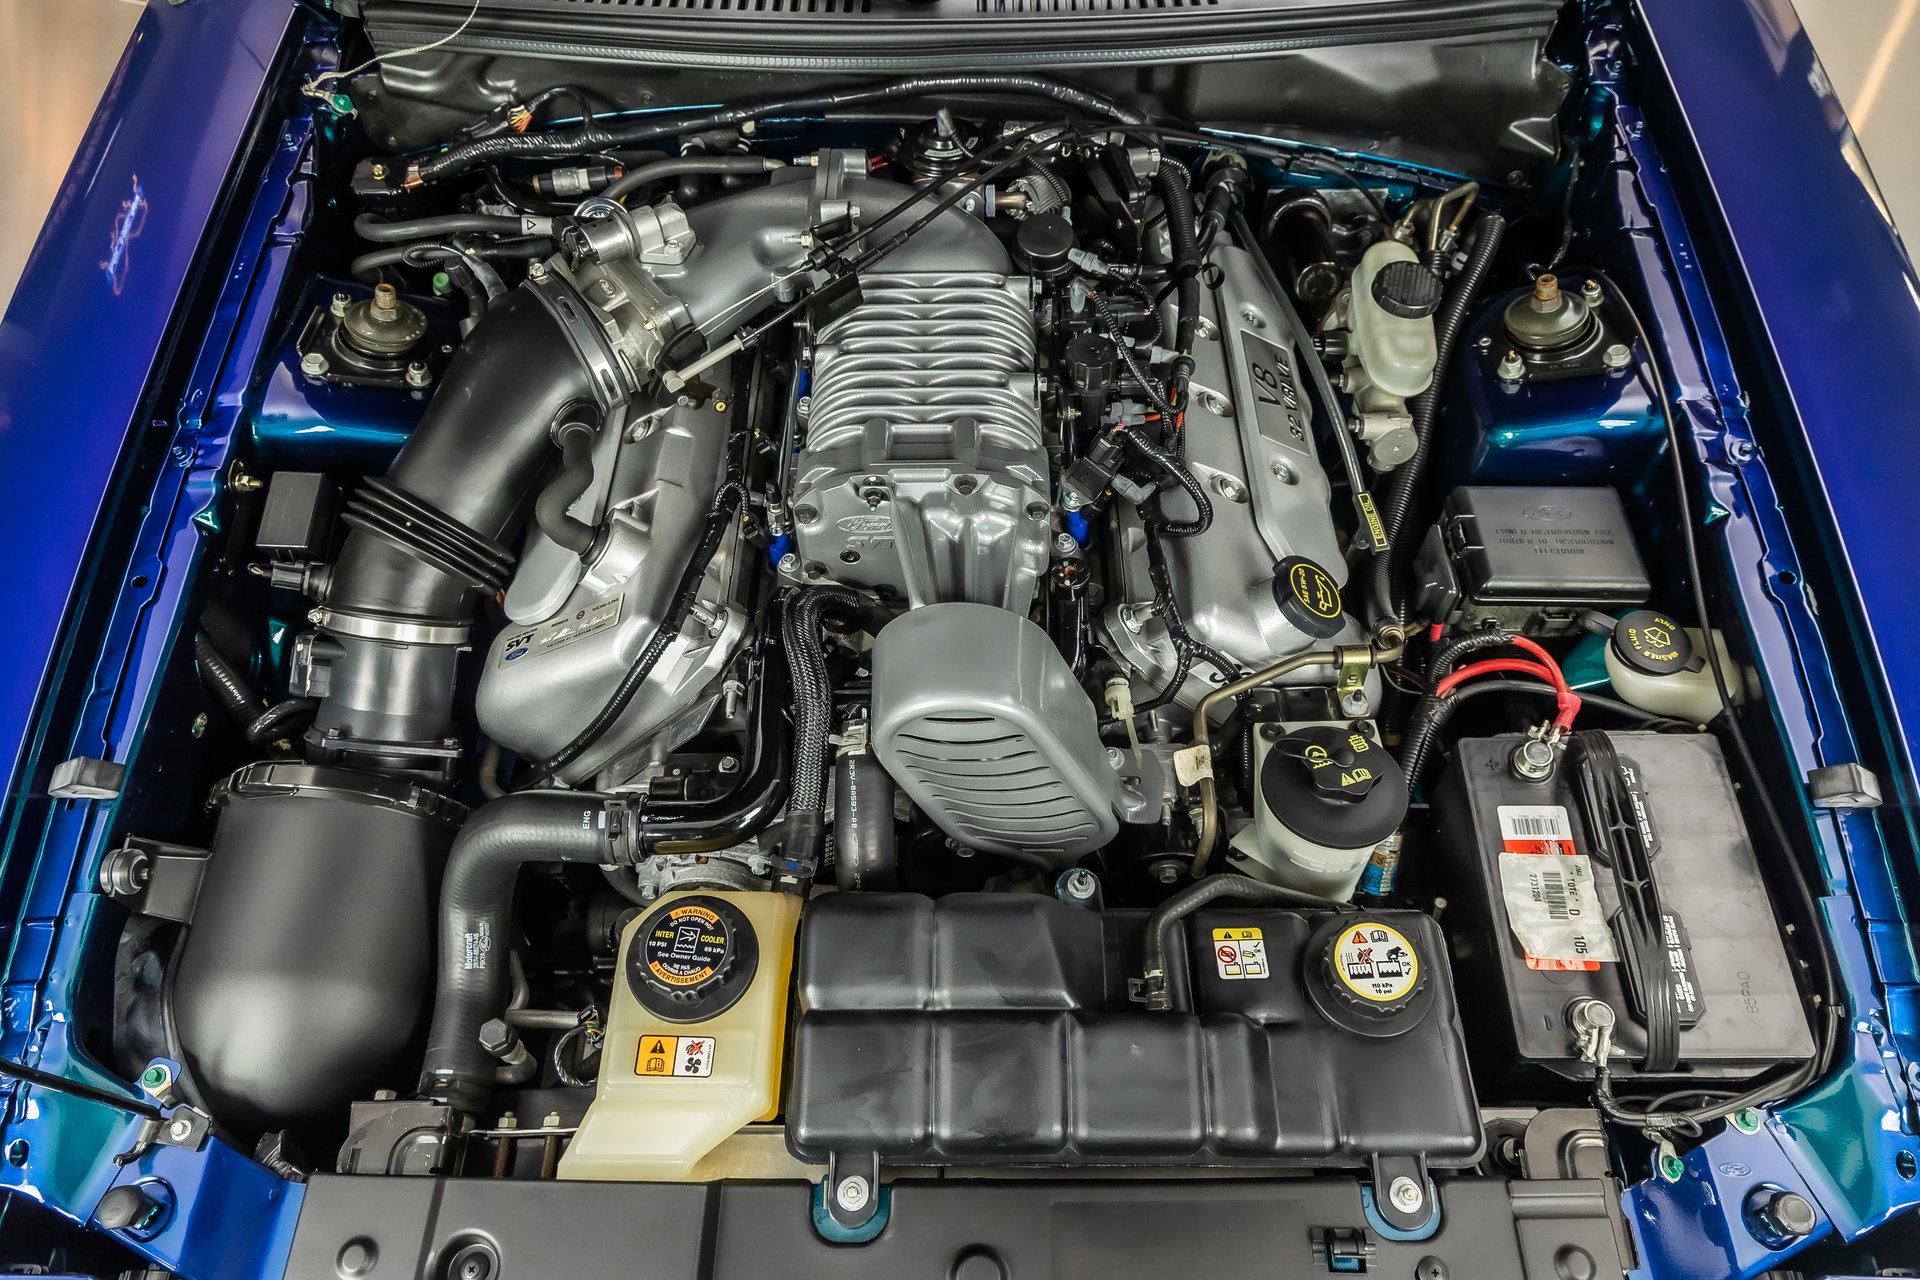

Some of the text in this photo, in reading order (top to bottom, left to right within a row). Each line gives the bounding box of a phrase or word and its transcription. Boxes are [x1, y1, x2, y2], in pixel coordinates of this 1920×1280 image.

[1252, 362, 1281, 407] V8
[1275, 353, 1305, 443] 32 VALVE
[1363, 499, 1384, 541] ENGINE OIL
[1298, 568, 1311, 604] SAE 5W-20
[505, 633, 535, 652] SVT
[1628, 617, 1680, 661] WASHER FLUID ONLY
[582, 810, 592, 829] ENG
[1529, 873, 1542, 903] 2731204
[681, 907, 715, 921] WARNING
[690, 916, 706, 925] OPEN
[704, 921, 715, 931] HOT
[1567, 878, 1588, 955] TOTE D 105
[464, 932, 473, 970] Motorcraft
[655, 930, 725, 944] INTER COOLER
[670, 952, 691, 960] Owner
[655, 968, 708, 983] AVERTISSEMENT
